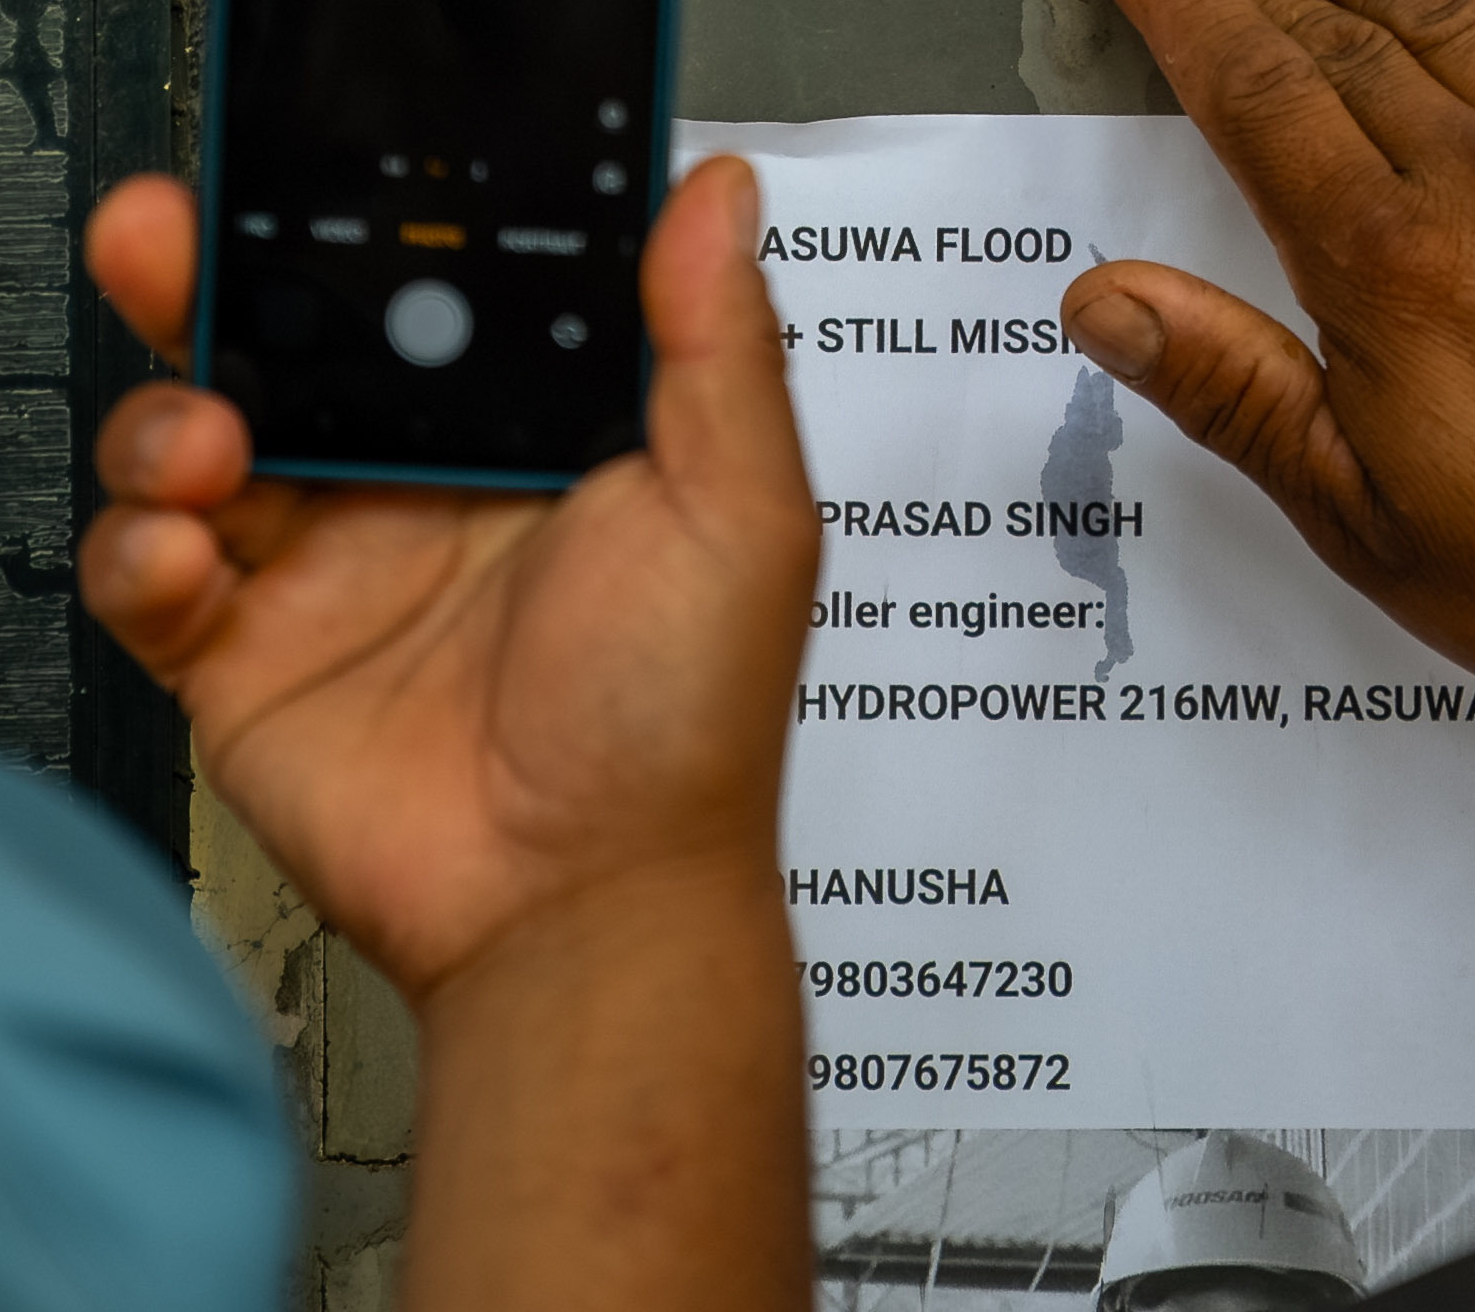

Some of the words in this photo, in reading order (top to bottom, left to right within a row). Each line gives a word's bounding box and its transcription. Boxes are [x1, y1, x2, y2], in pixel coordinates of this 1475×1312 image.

[758, 226, 923, 263] ASUWA
[935, 227, 1073, 264] FLOOD
[817, 318, 938, 355] STILL
[816, 501, 992, 537] PRASAD
[1005, 501, 1144, 539] SINGH
[809, 592, 896, 629] oller
[908, 593, 1106, 639] engineer:
[798, 684, 1106, 723] HYDROPOWER
[1120, 684, 1289, 729] 216MW,
[786, 868, 1010, 907] HANUSHA
[808, 1053, 1071, 1091] 9807675872
